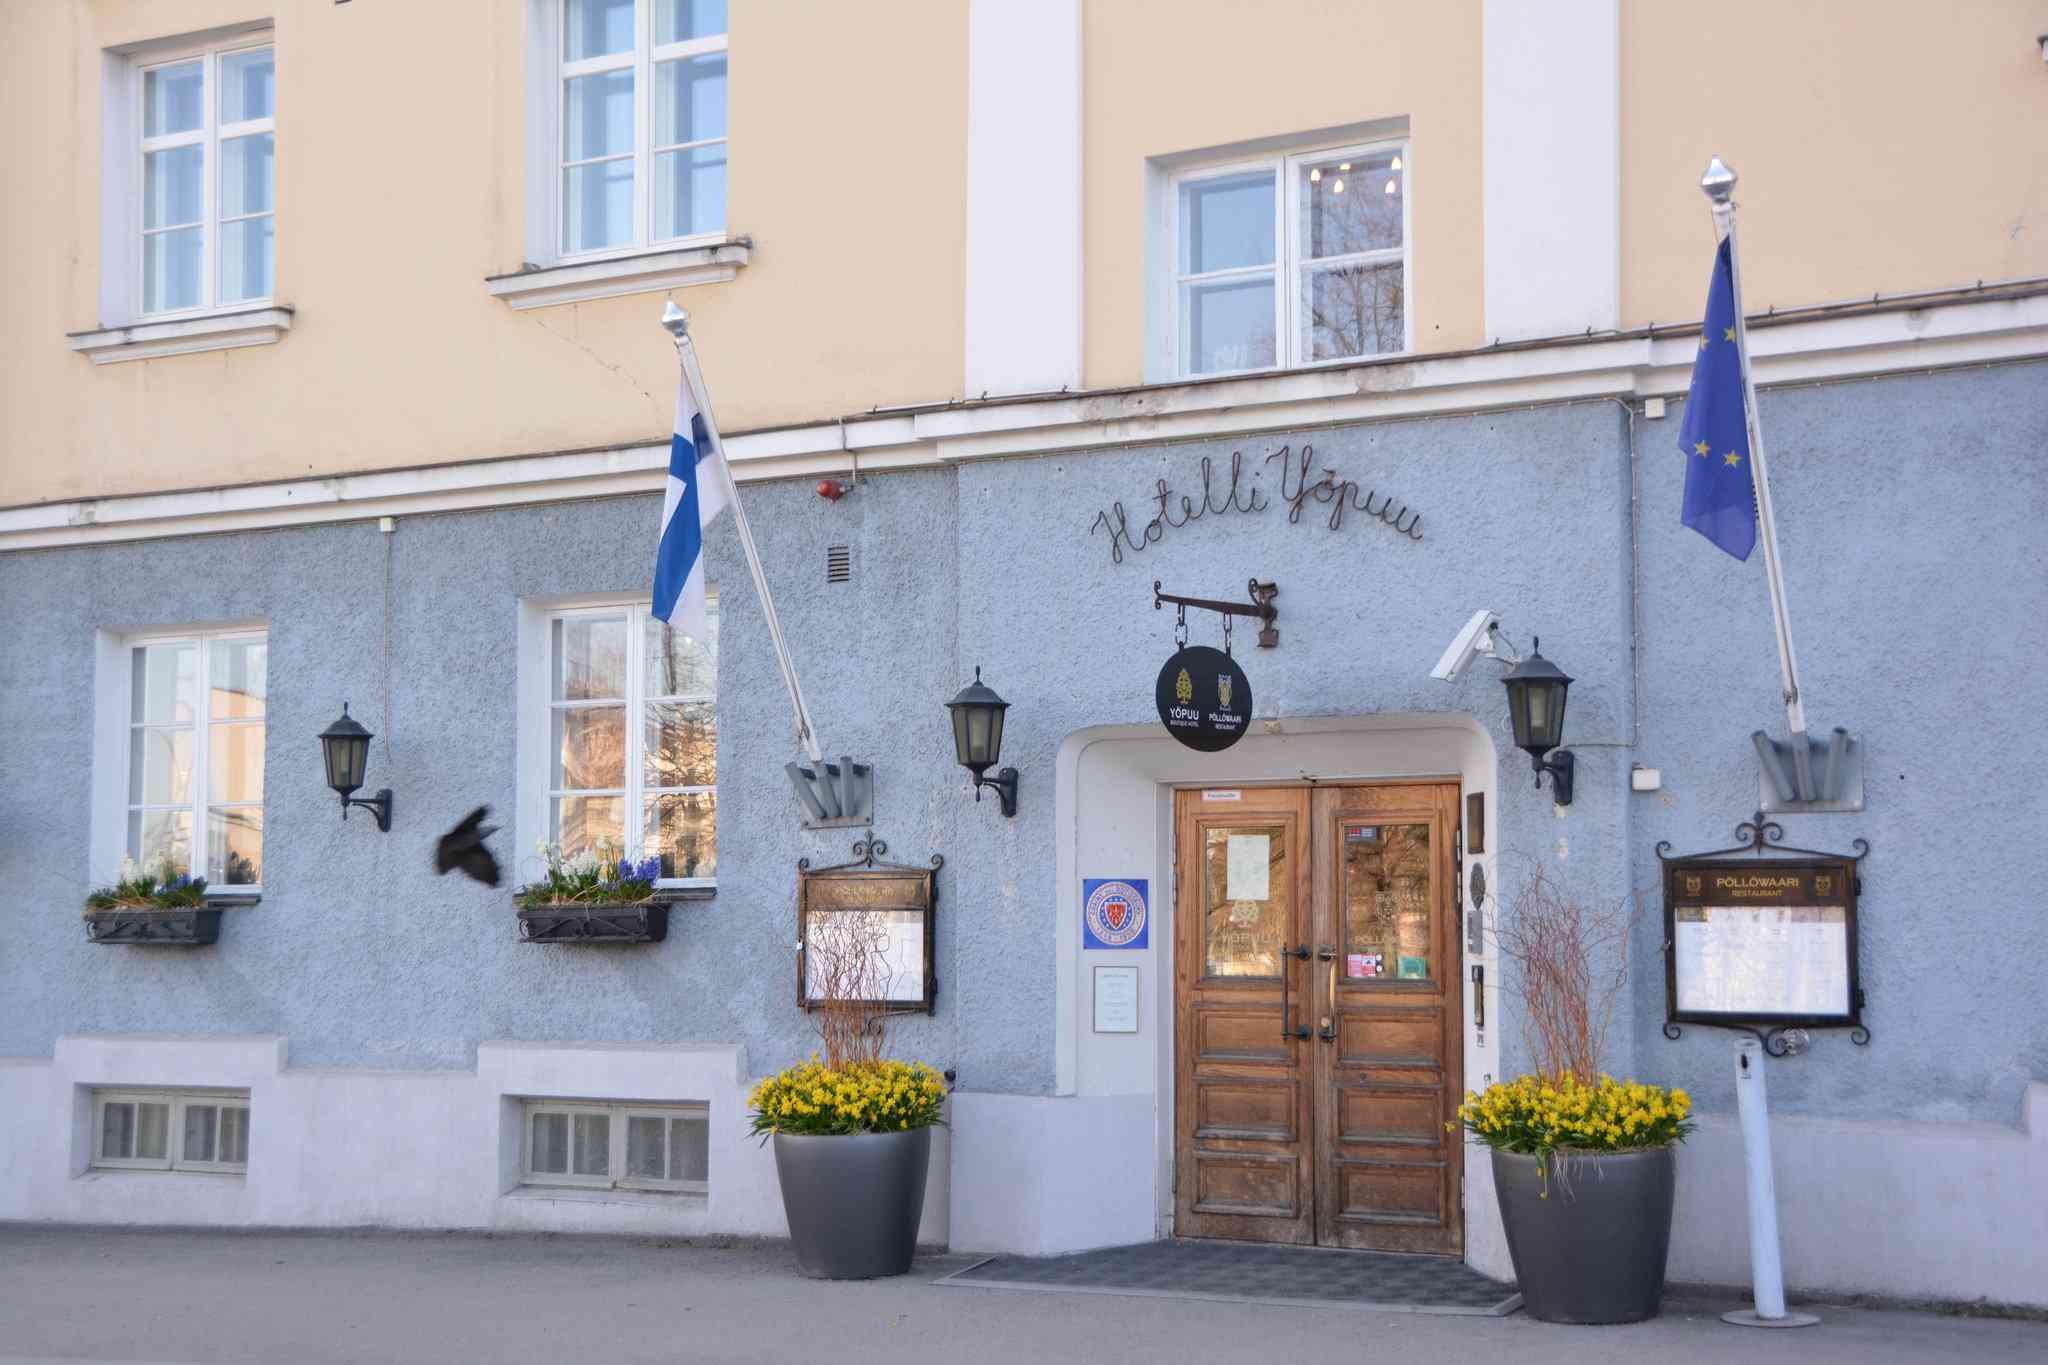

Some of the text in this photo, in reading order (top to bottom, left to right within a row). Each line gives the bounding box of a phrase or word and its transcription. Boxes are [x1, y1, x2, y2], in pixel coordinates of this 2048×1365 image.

[1091, 445, 1423, 563] Hotelli Yöpuu
[1170, 706, 1199, 720] YÖPUU
[1716, 876, 1799, 888] PÖLLÖWAARI
[1731, 889, 1783, 897] RESTAURANT
